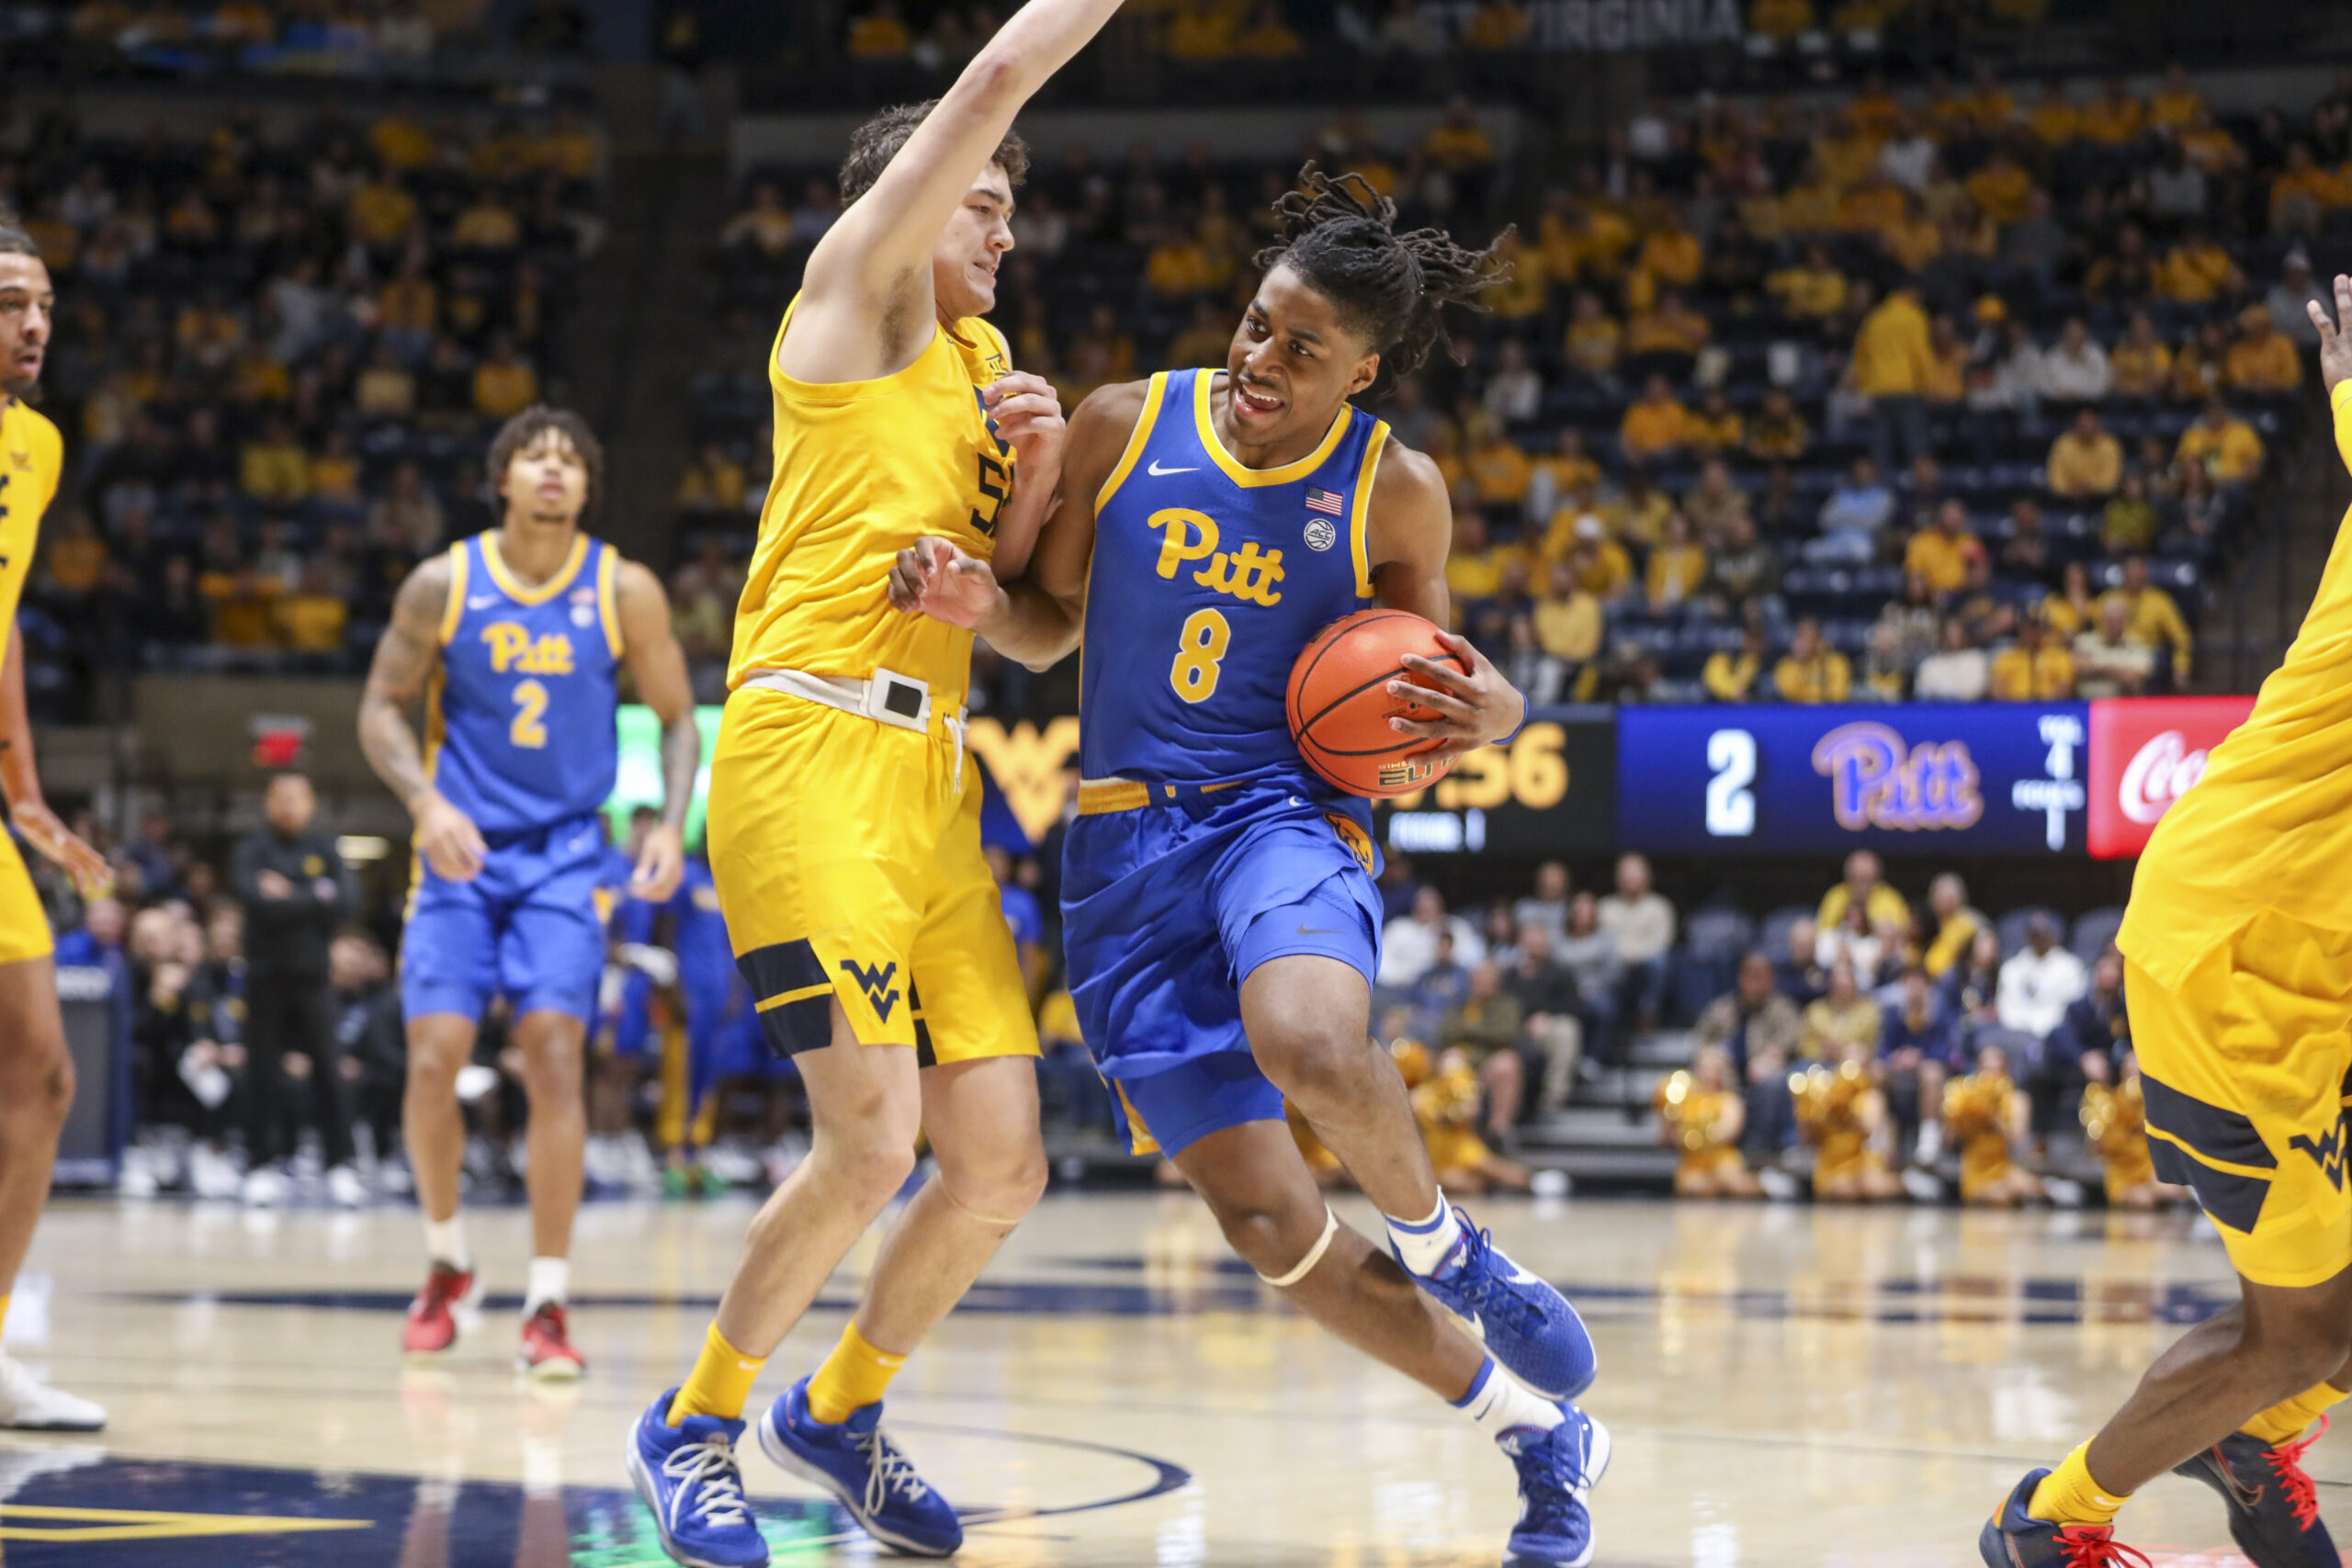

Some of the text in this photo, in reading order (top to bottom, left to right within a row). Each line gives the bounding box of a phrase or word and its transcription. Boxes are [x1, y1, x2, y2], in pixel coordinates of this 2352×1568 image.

[1148, 507, 1285, 606] Pitt
[1309, 528, 1333, 540] ACC
[481, 617, 575, 675] Pitt
[1170, 608, 1231, 704] 8
[510, 678, 550, 750] 2
[1706, 728, 1757, 837] 2
[1812, 720, 1984, 831] Pitt
[840, 959, 900, 1024] WV
